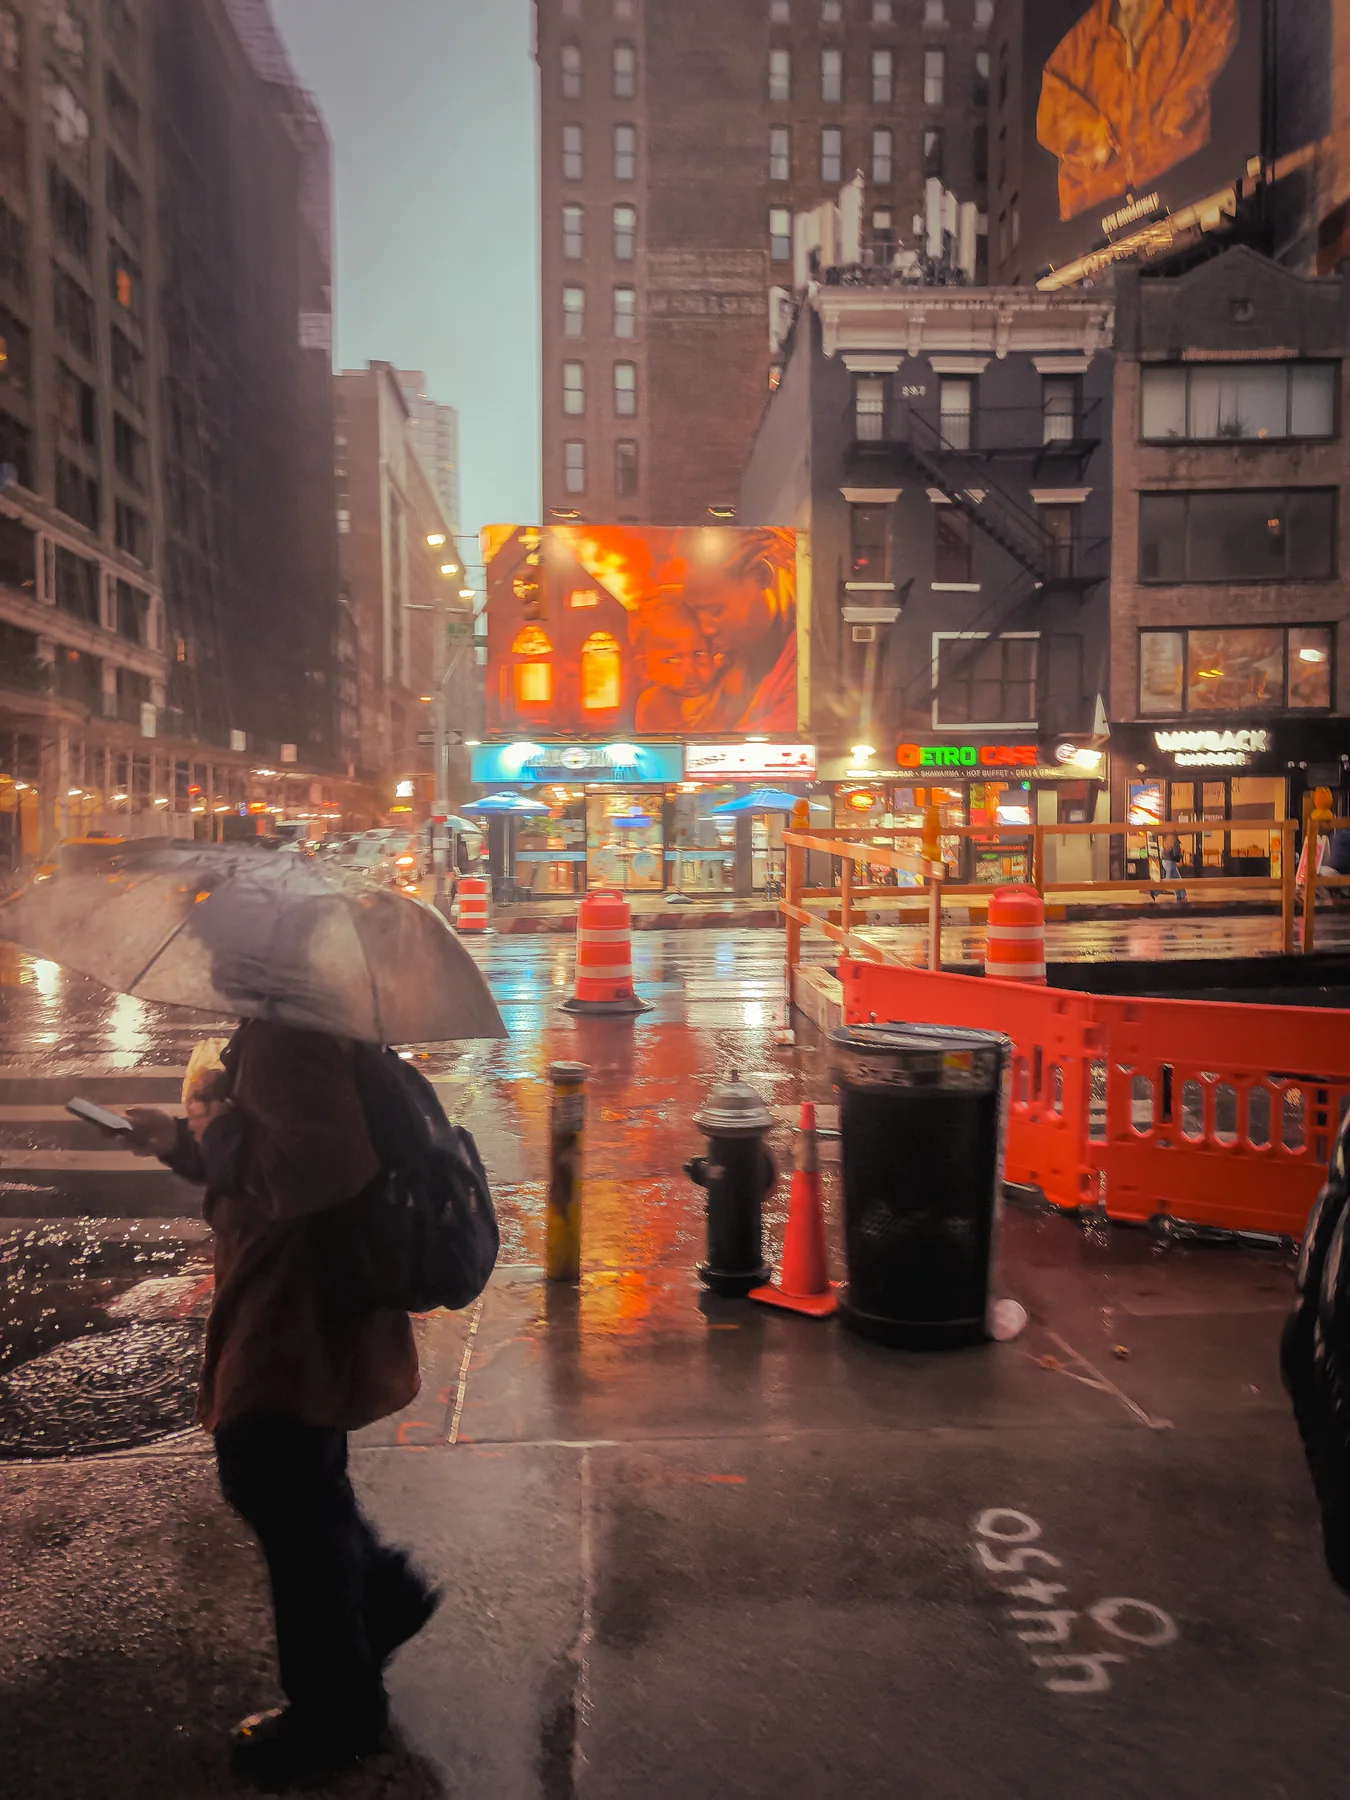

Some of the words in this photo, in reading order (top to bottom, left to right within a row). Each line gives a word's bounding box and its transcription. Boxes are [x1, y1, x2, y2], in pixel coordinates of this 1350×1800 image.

[897, 744, 976, 767] ETRO
[920, 769, 960, 778] SHAWARMA
[966, 769, 981, 778] HOT
[982, 769, 1009, 777] BUFFET
[1016, 768, 1032, 777] DELI
